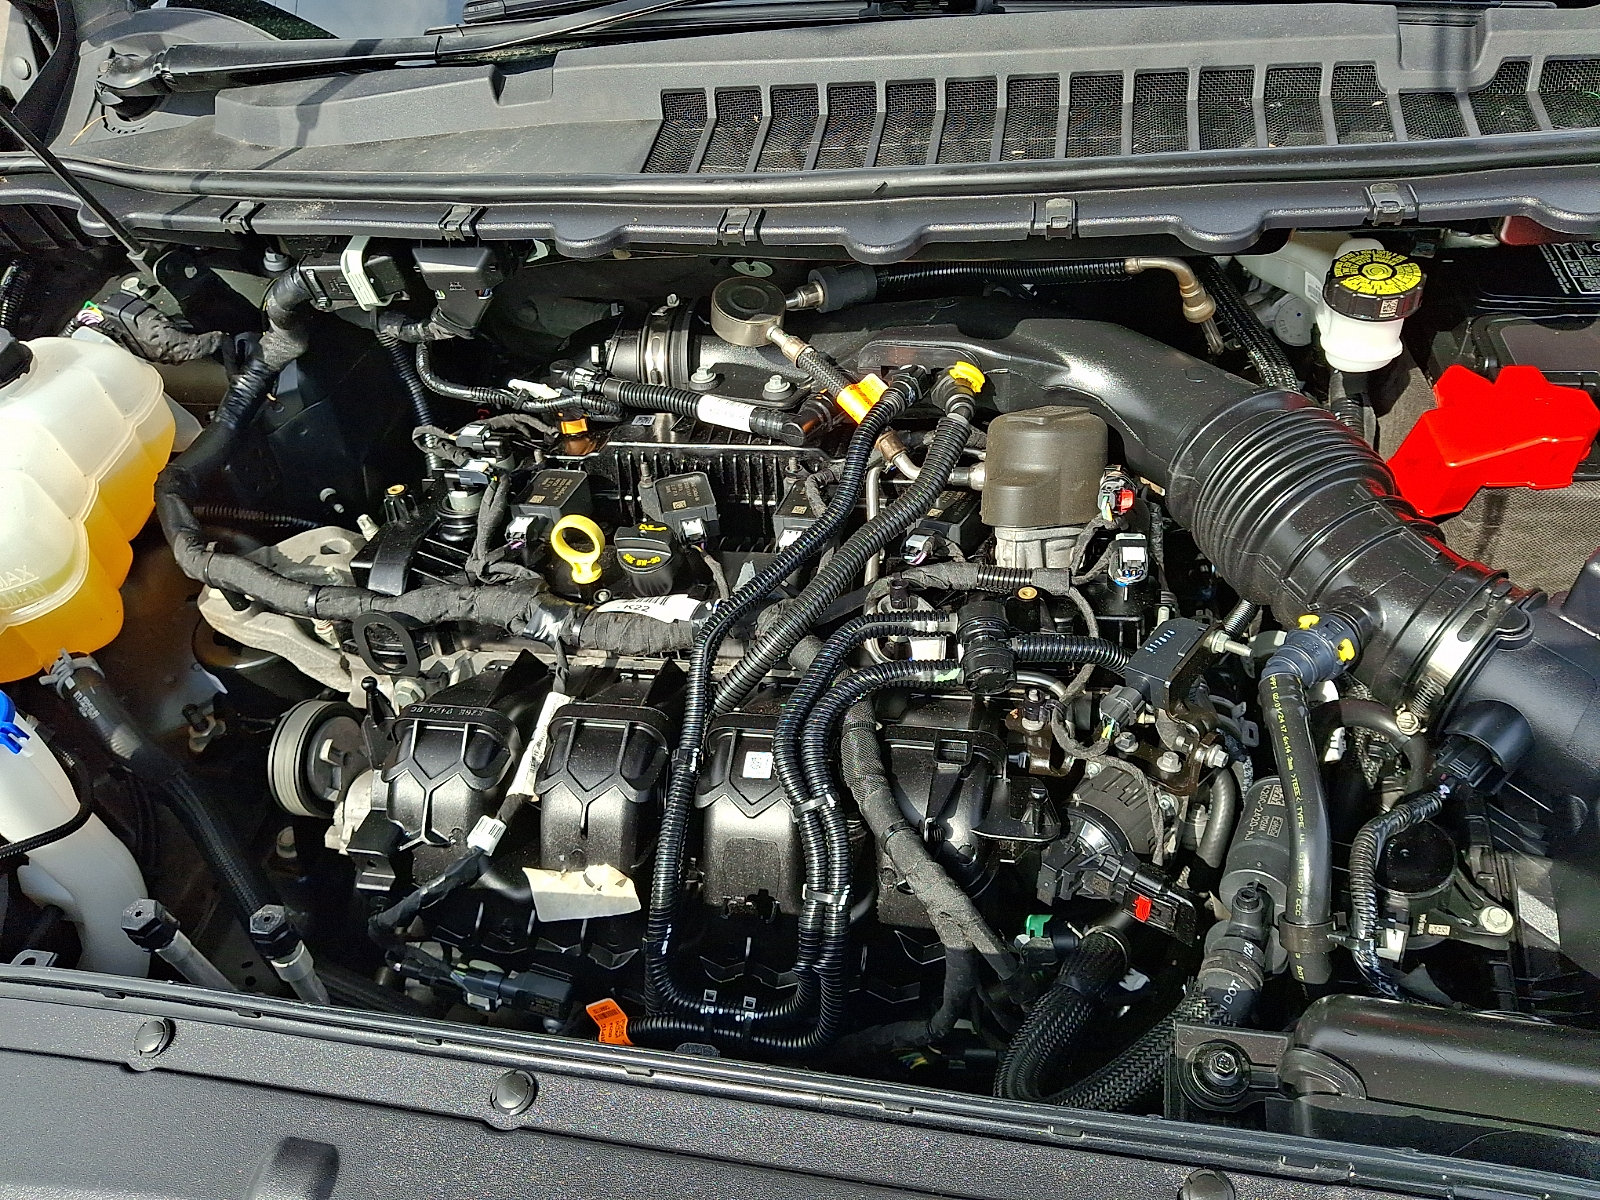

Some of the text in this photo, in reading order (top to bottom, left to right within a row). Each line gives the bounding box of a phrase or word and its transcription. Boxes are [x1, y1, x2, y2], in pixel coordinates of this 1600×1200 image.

[1296, 805, 1305, 829] TYPE
[1299, 832, 1306, 847] UL
[1295, 898, 1303, 917] CCC
[1223, 979, 1242, 1005] DOT
